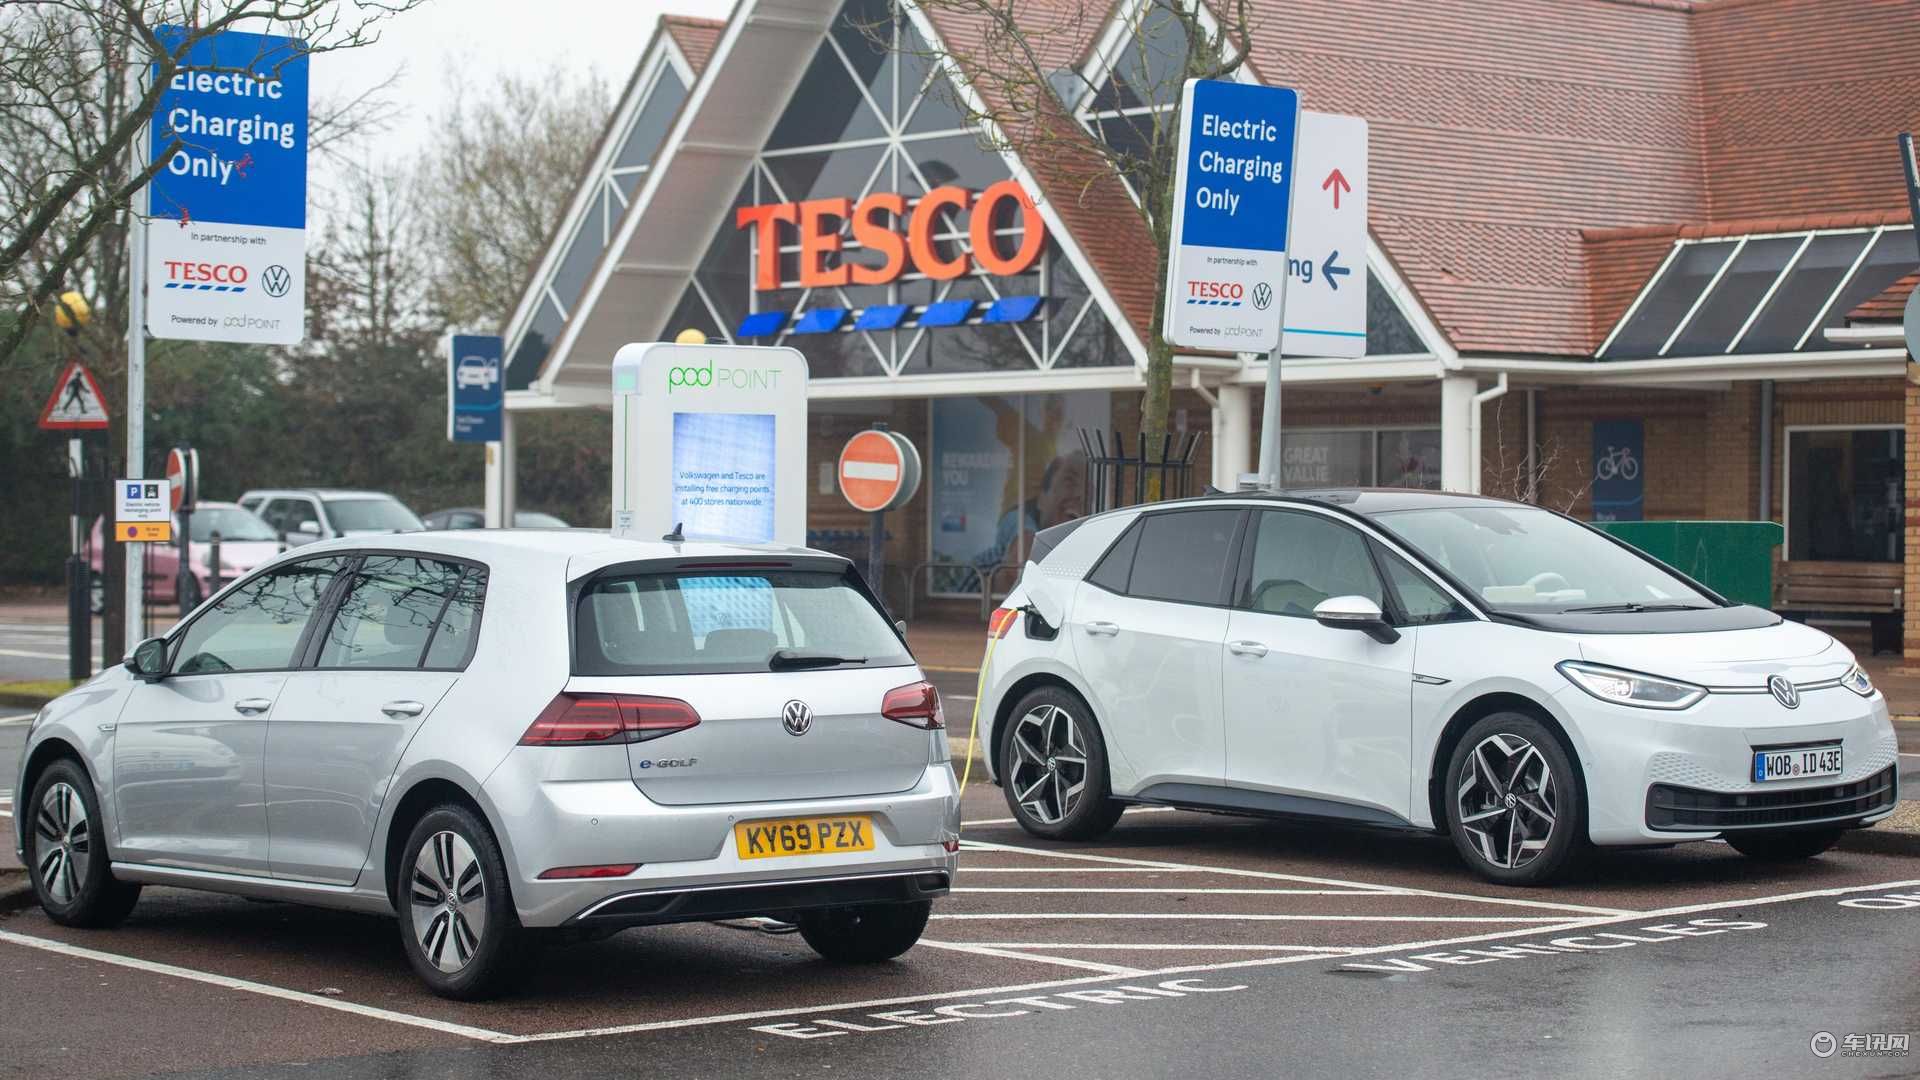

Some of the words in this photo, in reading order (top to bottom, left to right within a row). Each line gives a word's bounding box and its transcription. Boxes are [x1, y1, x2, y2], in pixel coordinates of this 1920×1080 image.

[170, 66, 283, 100] Electric
[168, 107, 296, 149] Charging
[1202, 114, 1277, 142] Electric
[168, 150, 236, 186] Only
[1199, 150, 1283, 184] Charging
[1196, 186, 1240, 217] Only
[191, 232, 199, 241] In
[201, 234, 248, 245] partnership
[250, 237, 267, 245] with
[736, 180, 1047, 292] TESCO
[165, 261, 248, 284] TESCO
[1207, 256, 1213, 264] In
[1214, 257, 1246, 266] partnership
[1188, 281, 1244, 299] TESCO
[171, 314, 206, 324] Powered
[207, 316, 218, 326] by
[247, 318, 281, 330] POINT
[1189, 326, 1212, 335] Powered
[1213, 328, 1221, 336] by
[669, 360, 713, 394] pod
[718, 368, 782, 390] POINT
[675, 485, 704, 493] installing
[720, 485, 748, 493] charging
[680, 472, 720, 480] Volkswagen
[735, 472, 753, 480] Tesco
[640, 758, 698, 769] e-GOLF
[1766, 755, 1792, 776] WOB
[1802, 753, 1817, 774] ID
[1819, 751, 1841, 771] 43E
[747, 825, 812, 854] KY69
[818, 820, 865, 849] PZX
[1341, 917, 1769, 972] VEHICLES
[748, 978, 1249, 1039] ELECTRIC
